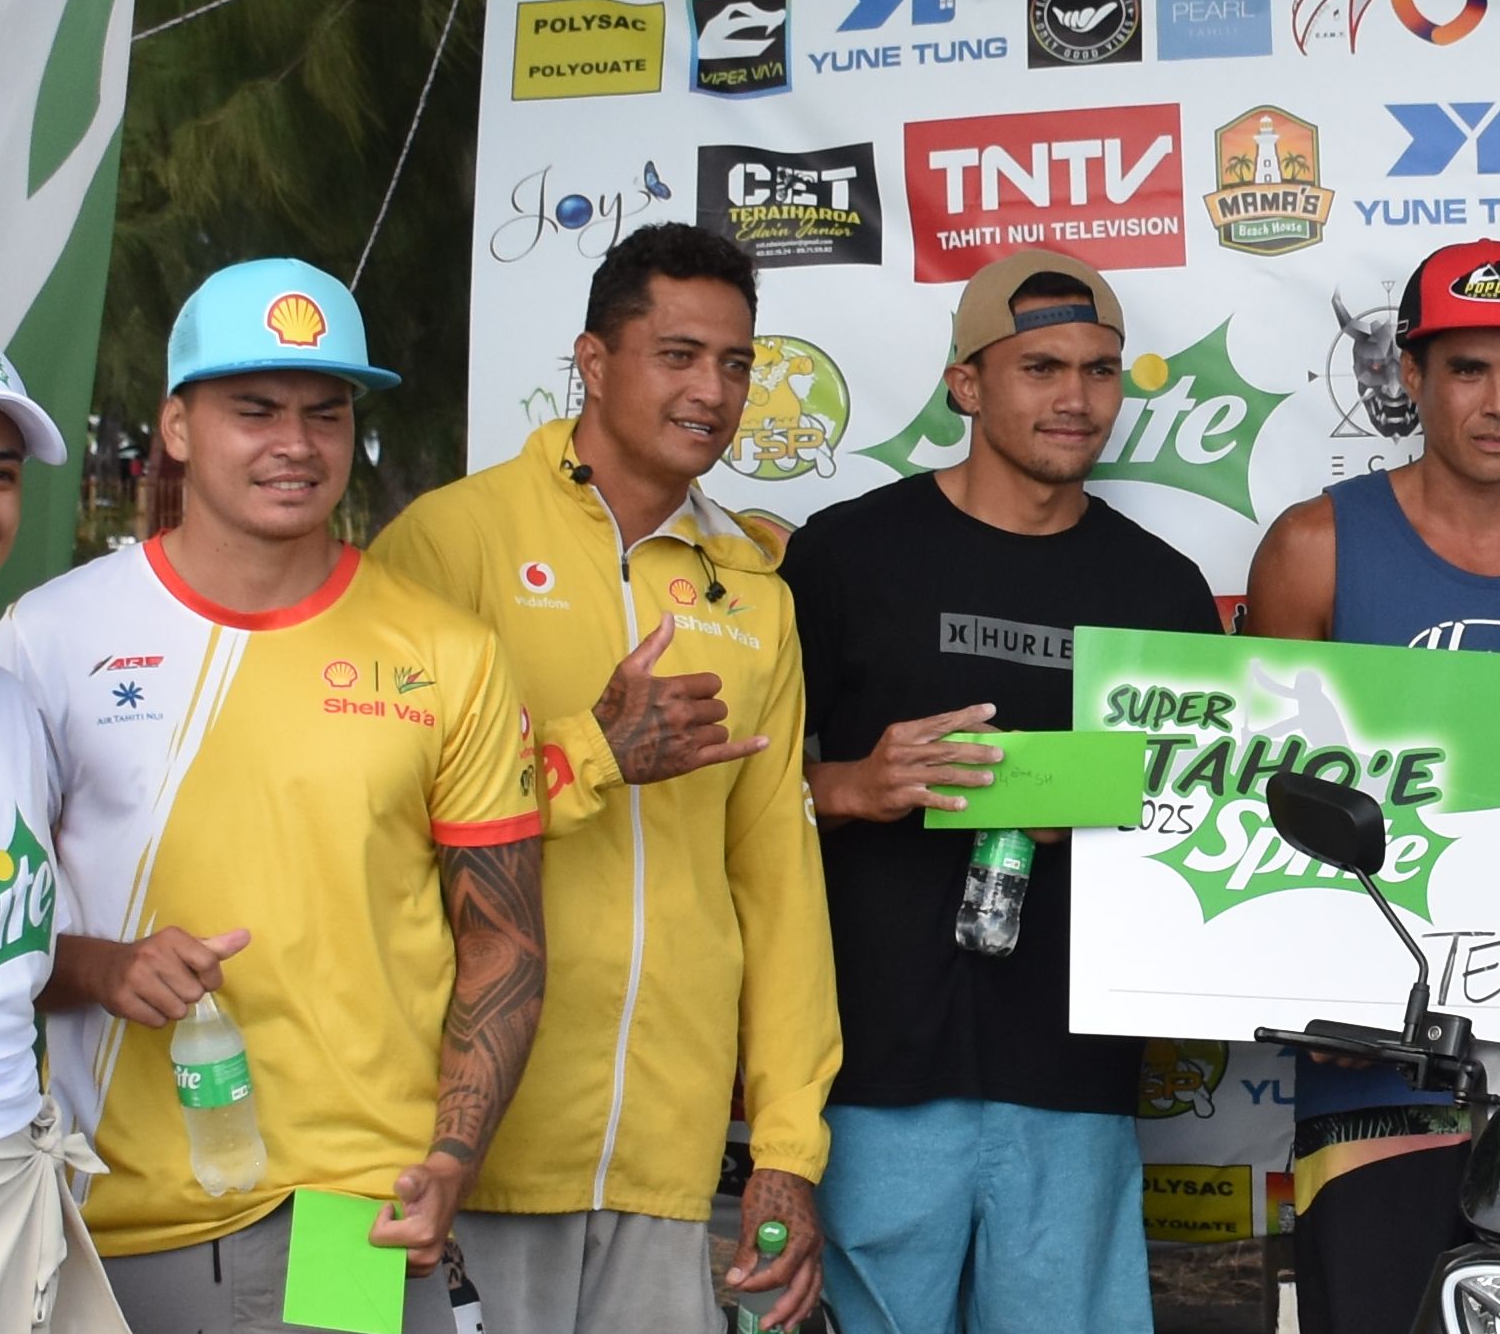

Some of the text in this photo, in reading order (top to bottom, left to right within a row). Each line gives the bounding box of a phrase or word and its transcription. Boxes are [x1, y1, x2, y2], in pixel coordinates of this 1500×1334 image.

[533, 13, 647, 35] POLYSAC
[1172, 0, 1255, 24] PEARL
[528, 58, 647, 78] POLYOUATE
[808, 37, 1009, 74] YUNE TUNG
[700, 61, 784, 85] VIPER VA'A
[728, 163, 858, 210] CET
[928, 134, 1173, 215] TNTV
[729, 205, 861, 225] TERAIHAROA
[1218, 186, 1322, 219] MAMA'S
[1354, 198, 1468, 225] YUNE
[736, 216, 853, 241] Edwin Junior
[937, 216, 1179, 251] TAHITI NUI TELEVISION
[1239, 222, 1303, 237] Beach House
[515, 595, 570, 610] vodafone
[674, 614, 762, 650] Shell Va'a
[982, 627, 1074, 659] HURLE
[323, 698, 436, 728] Shell Va'a
[1104, 683, 1236, 733] SUPER
[1145, 733, 1446, 806] TAHO'E
[174, 1065, 202, 1090] ite
[1143, 1179, 1235, 1197] LYSAC
